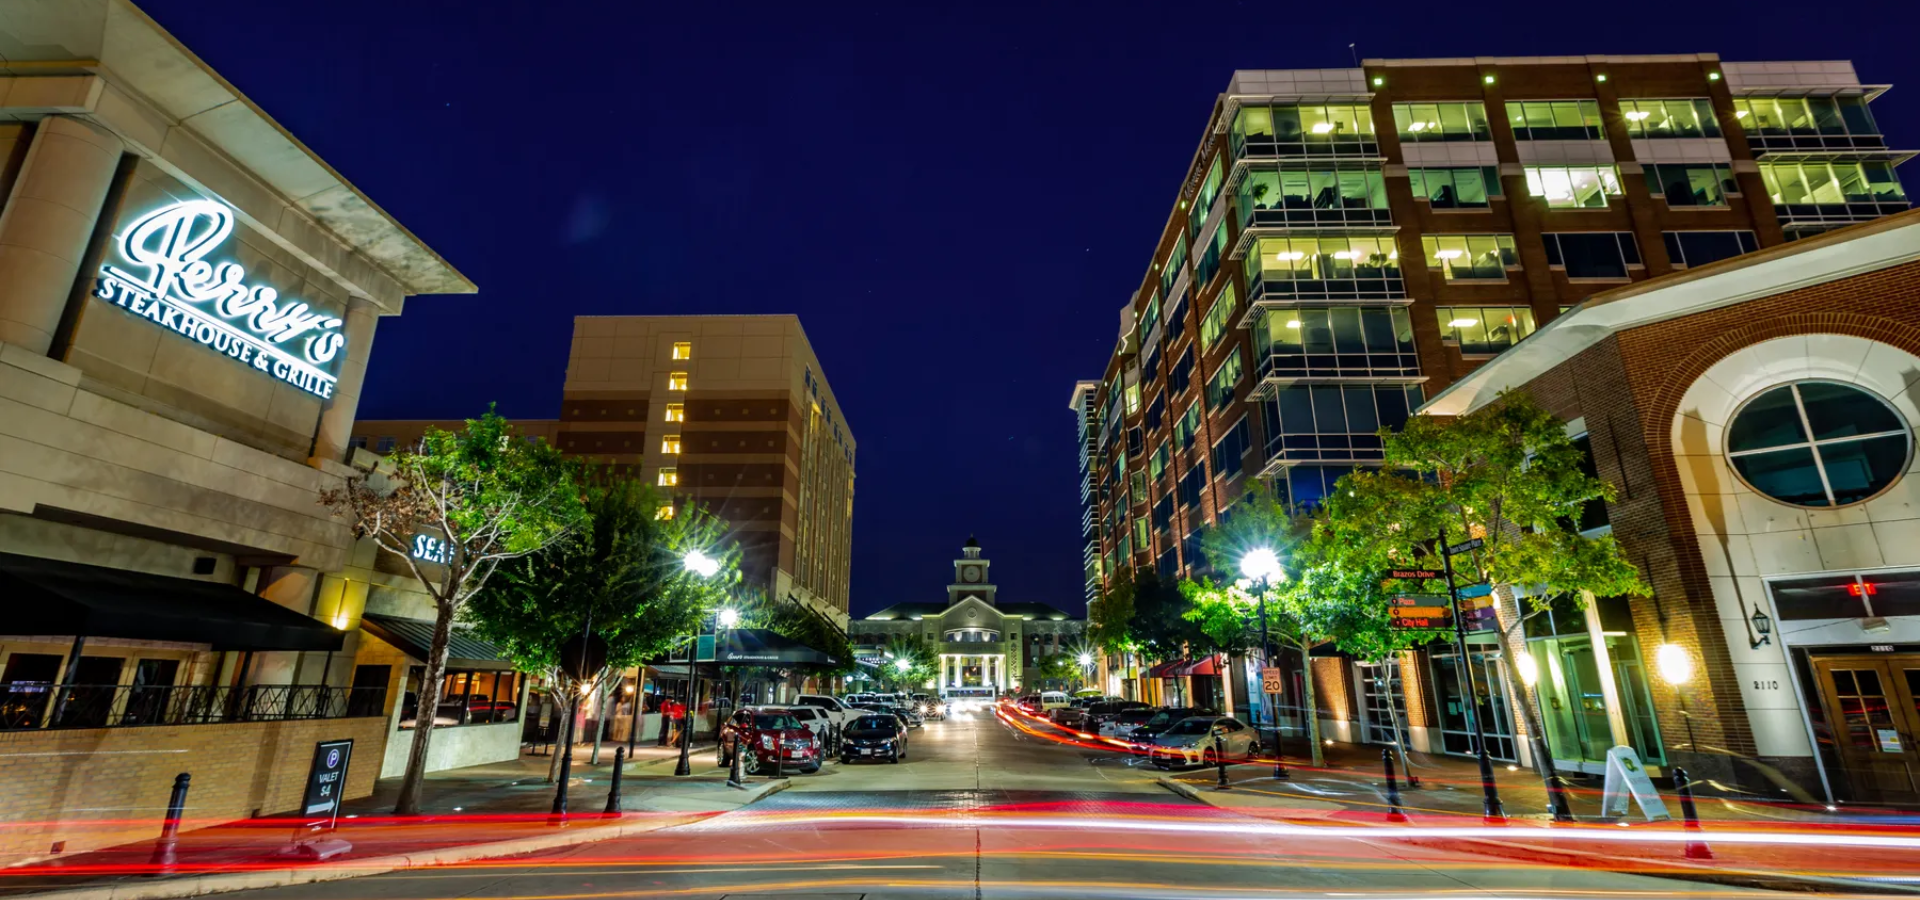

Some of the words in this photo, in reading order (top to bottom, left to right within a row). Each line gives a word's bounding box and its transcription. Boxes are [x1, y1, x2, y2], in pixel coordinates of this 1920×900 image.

[117, 198, 345, 364] Perry's
[97, 277, 253, 363] STEAKHOUSE
[252, 350, 270, 373] &
[272, 360, 334, 400] GRILLE
[1392, 570, 1416, 578] Brazos
[1416, 570, 1436, 578] Drive
[1401, 618, 1415, 628] City
[1416, 618, 1429, 627] Hall
[1265, 681, 1280, 691] 20
[1753, 680, 1778, 690] 2110
[319, 771, 339, 784] VALET
[320, 784, 331, 797] $4
